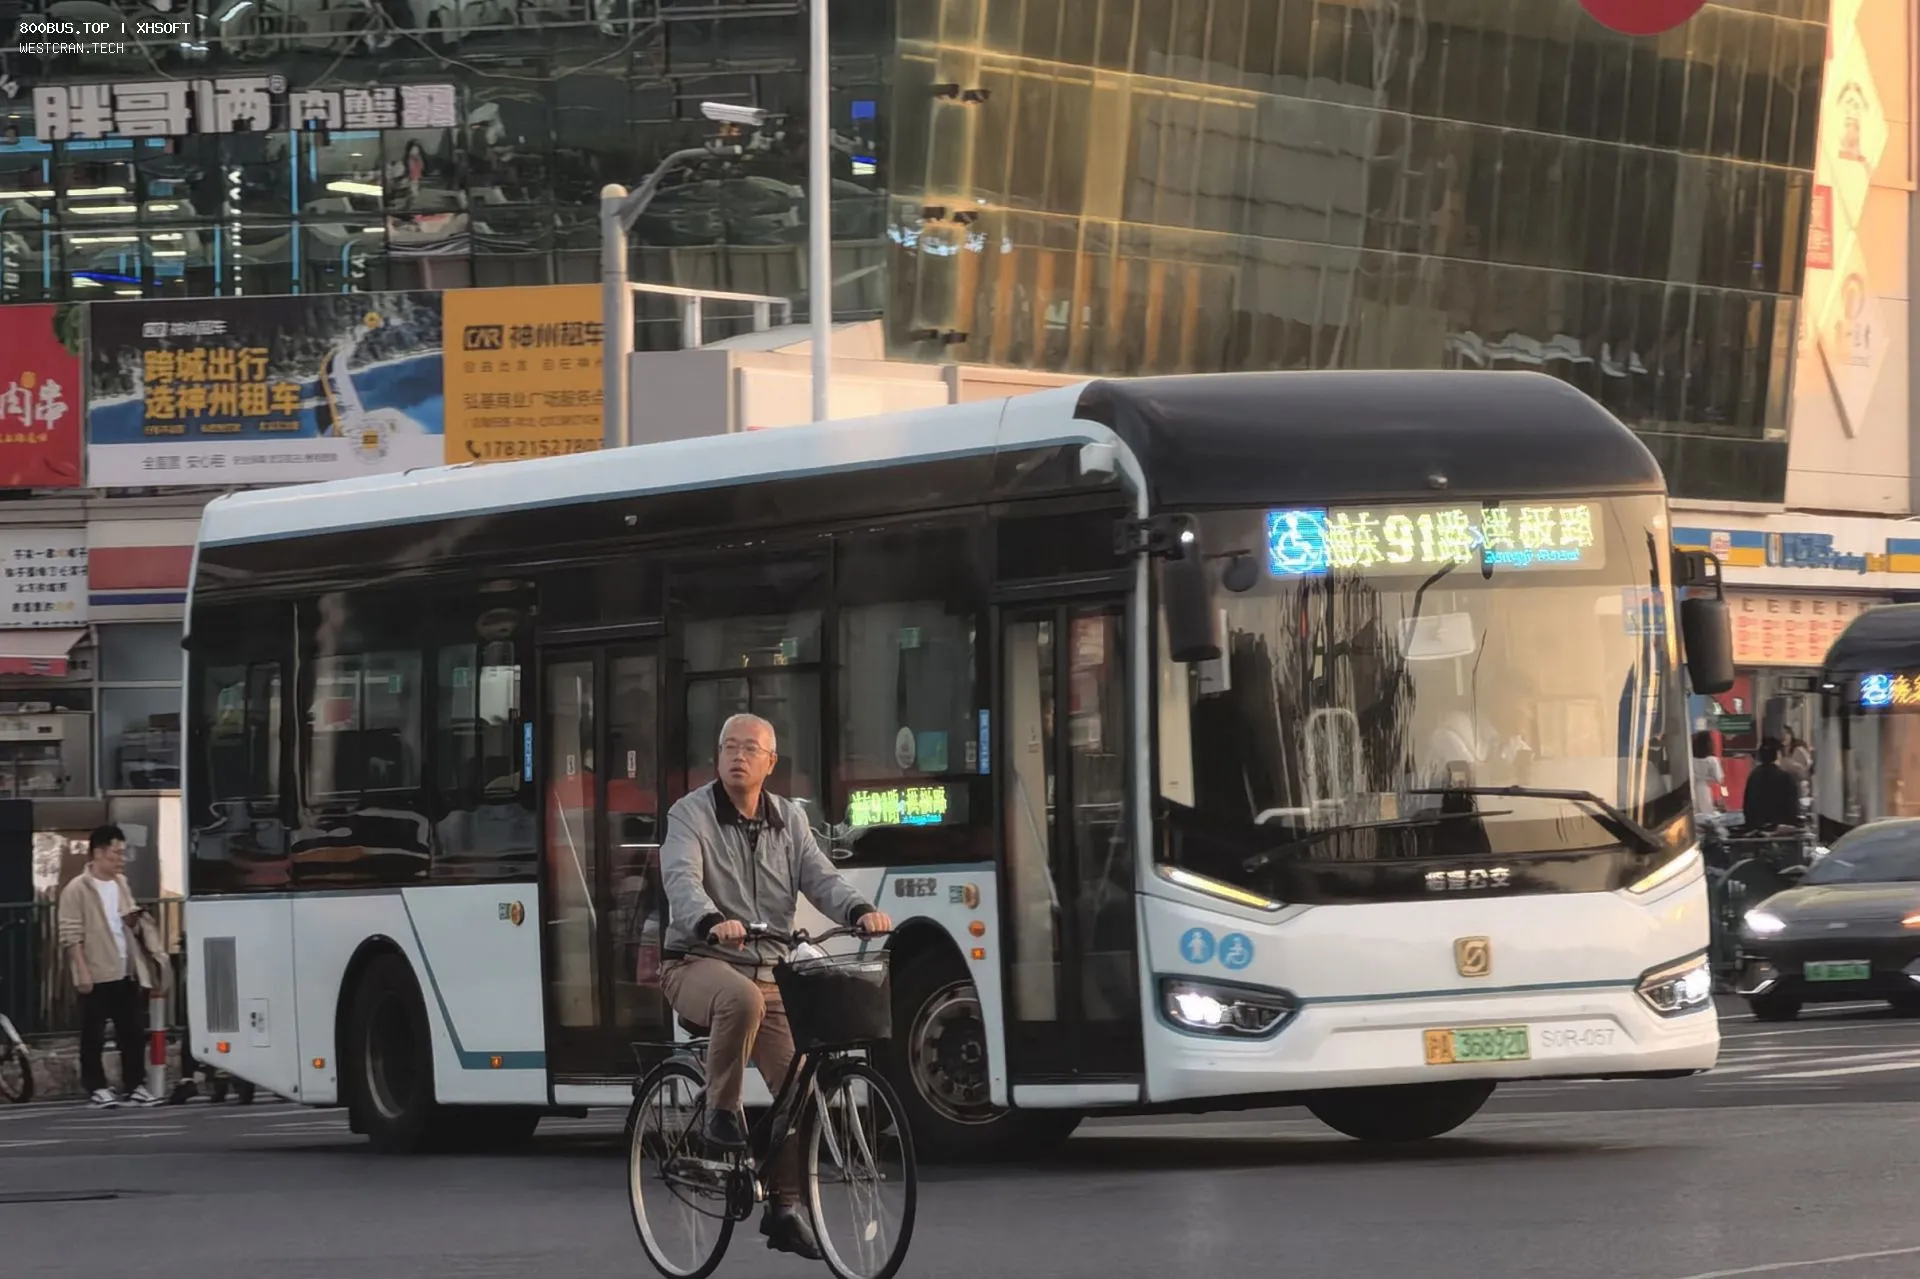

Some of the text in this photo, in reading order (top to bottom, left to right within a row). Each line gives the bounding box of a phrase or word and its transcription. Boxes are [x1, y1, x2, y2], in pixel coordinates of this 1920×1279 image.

[509, 322, 605, 348] 神州租车
[144, 347, 269, 383] 跨城出行
[144, 372, 300, 419] 选神州租车
